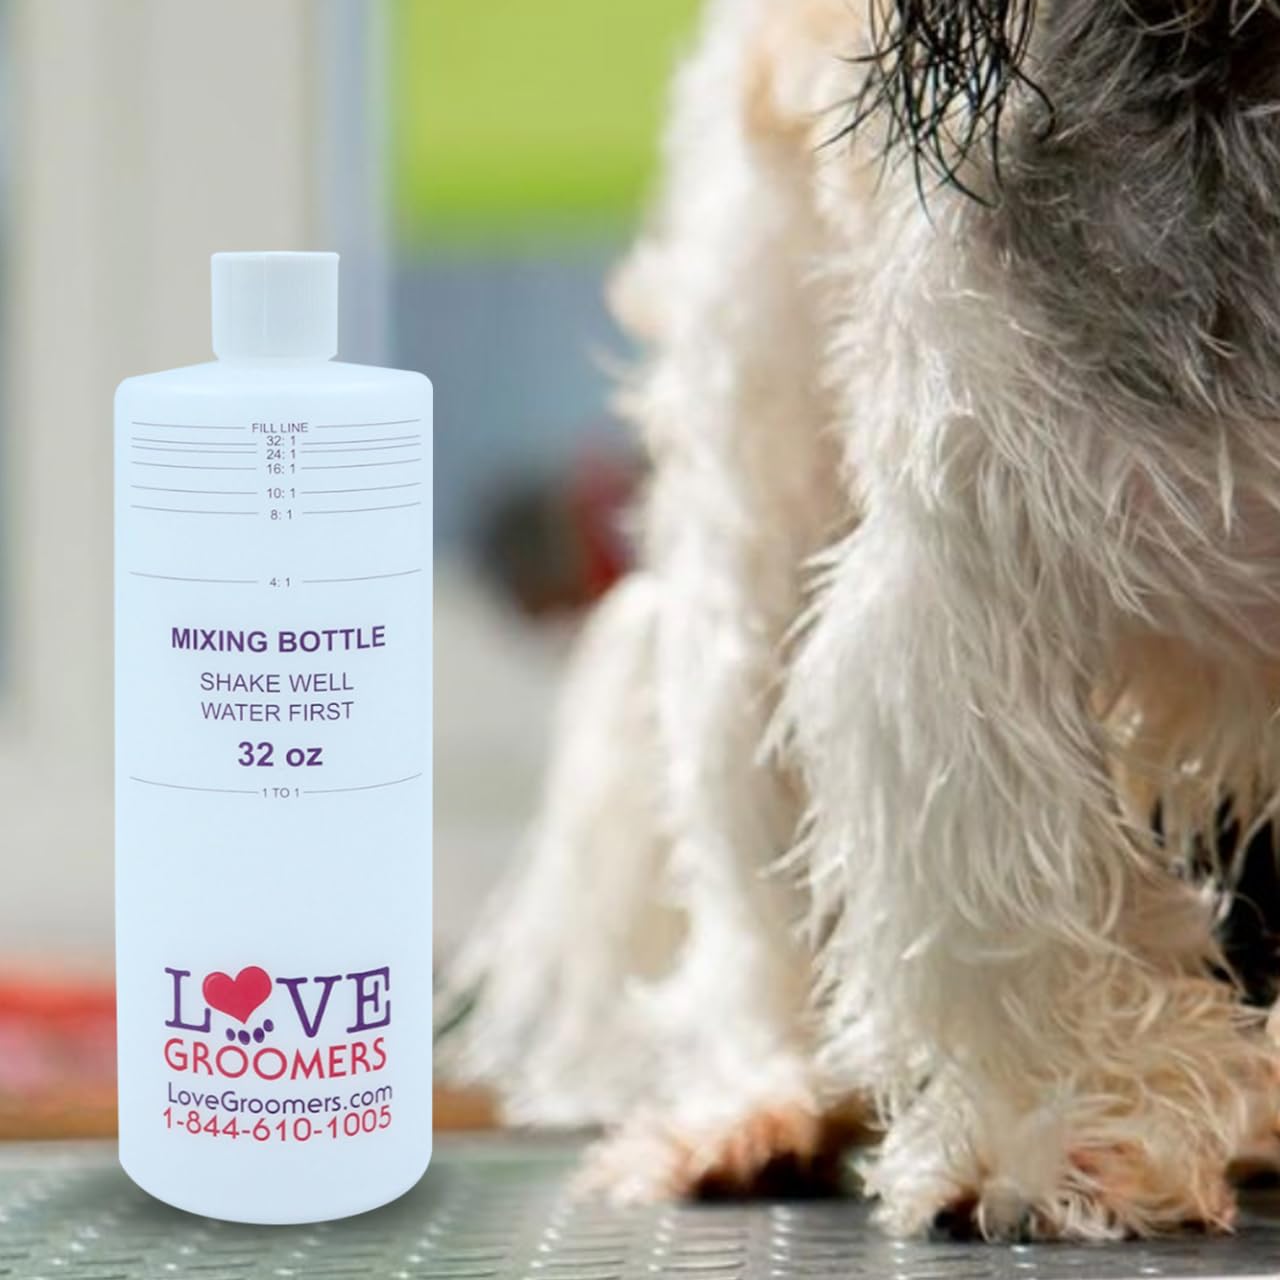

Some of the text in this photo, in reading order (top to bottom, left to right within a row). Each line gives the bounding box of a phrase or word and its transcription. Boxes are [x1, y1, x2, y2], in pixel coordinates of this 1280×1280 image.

[251, 422, 309, 434] FILL LINE
[171, 625, 386, 653] MIXING BOTTLE
[200, 672, 354, 693] SHAKE WELL
[200, 701, 355, 722] WATER FIRST
[237, 741, 324, 767] 32 oz
[262, 788, 300, 799] 1 TO 1
[164, 1036, 387, 1081] GROOMERS
[168, 1081, 393, 1114] LoveGroomers.com
[163, 1104, 392, 1142] 1-844-610-1005
